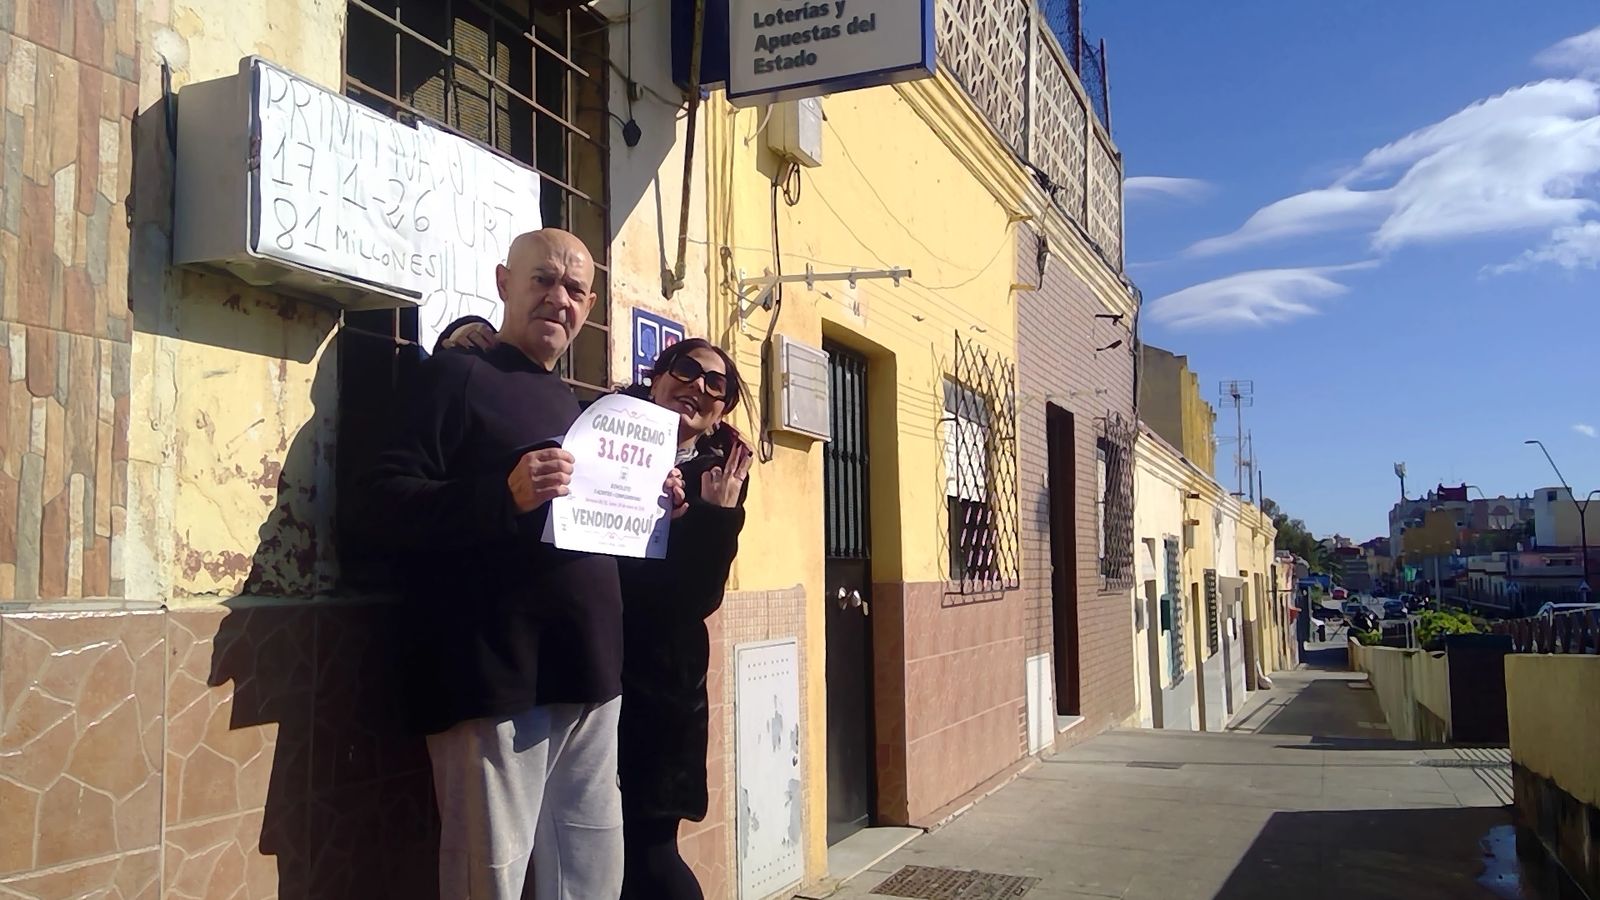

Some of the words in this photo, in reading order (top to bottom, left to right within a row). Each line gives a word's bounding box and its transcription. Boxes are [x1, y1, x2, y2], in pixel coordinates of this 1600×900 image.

[754, 2, 829, 29] Loterías
[835, 0, 846, 19] y
[754, 23, 841, 53] Apuestas
[847, 13, 876, 35] del
[754, 50, 818, 75] Estado
[273, 197, 327, 251] 81
[592, 414, 626, 436] GRAN
[626, 422, 665, 446] PREMIO
[597, 436, 653, 469] 31.671€
[572, 506, 624, 530] VENDIDO
[623, 514, 654, 537] AQUÍ
